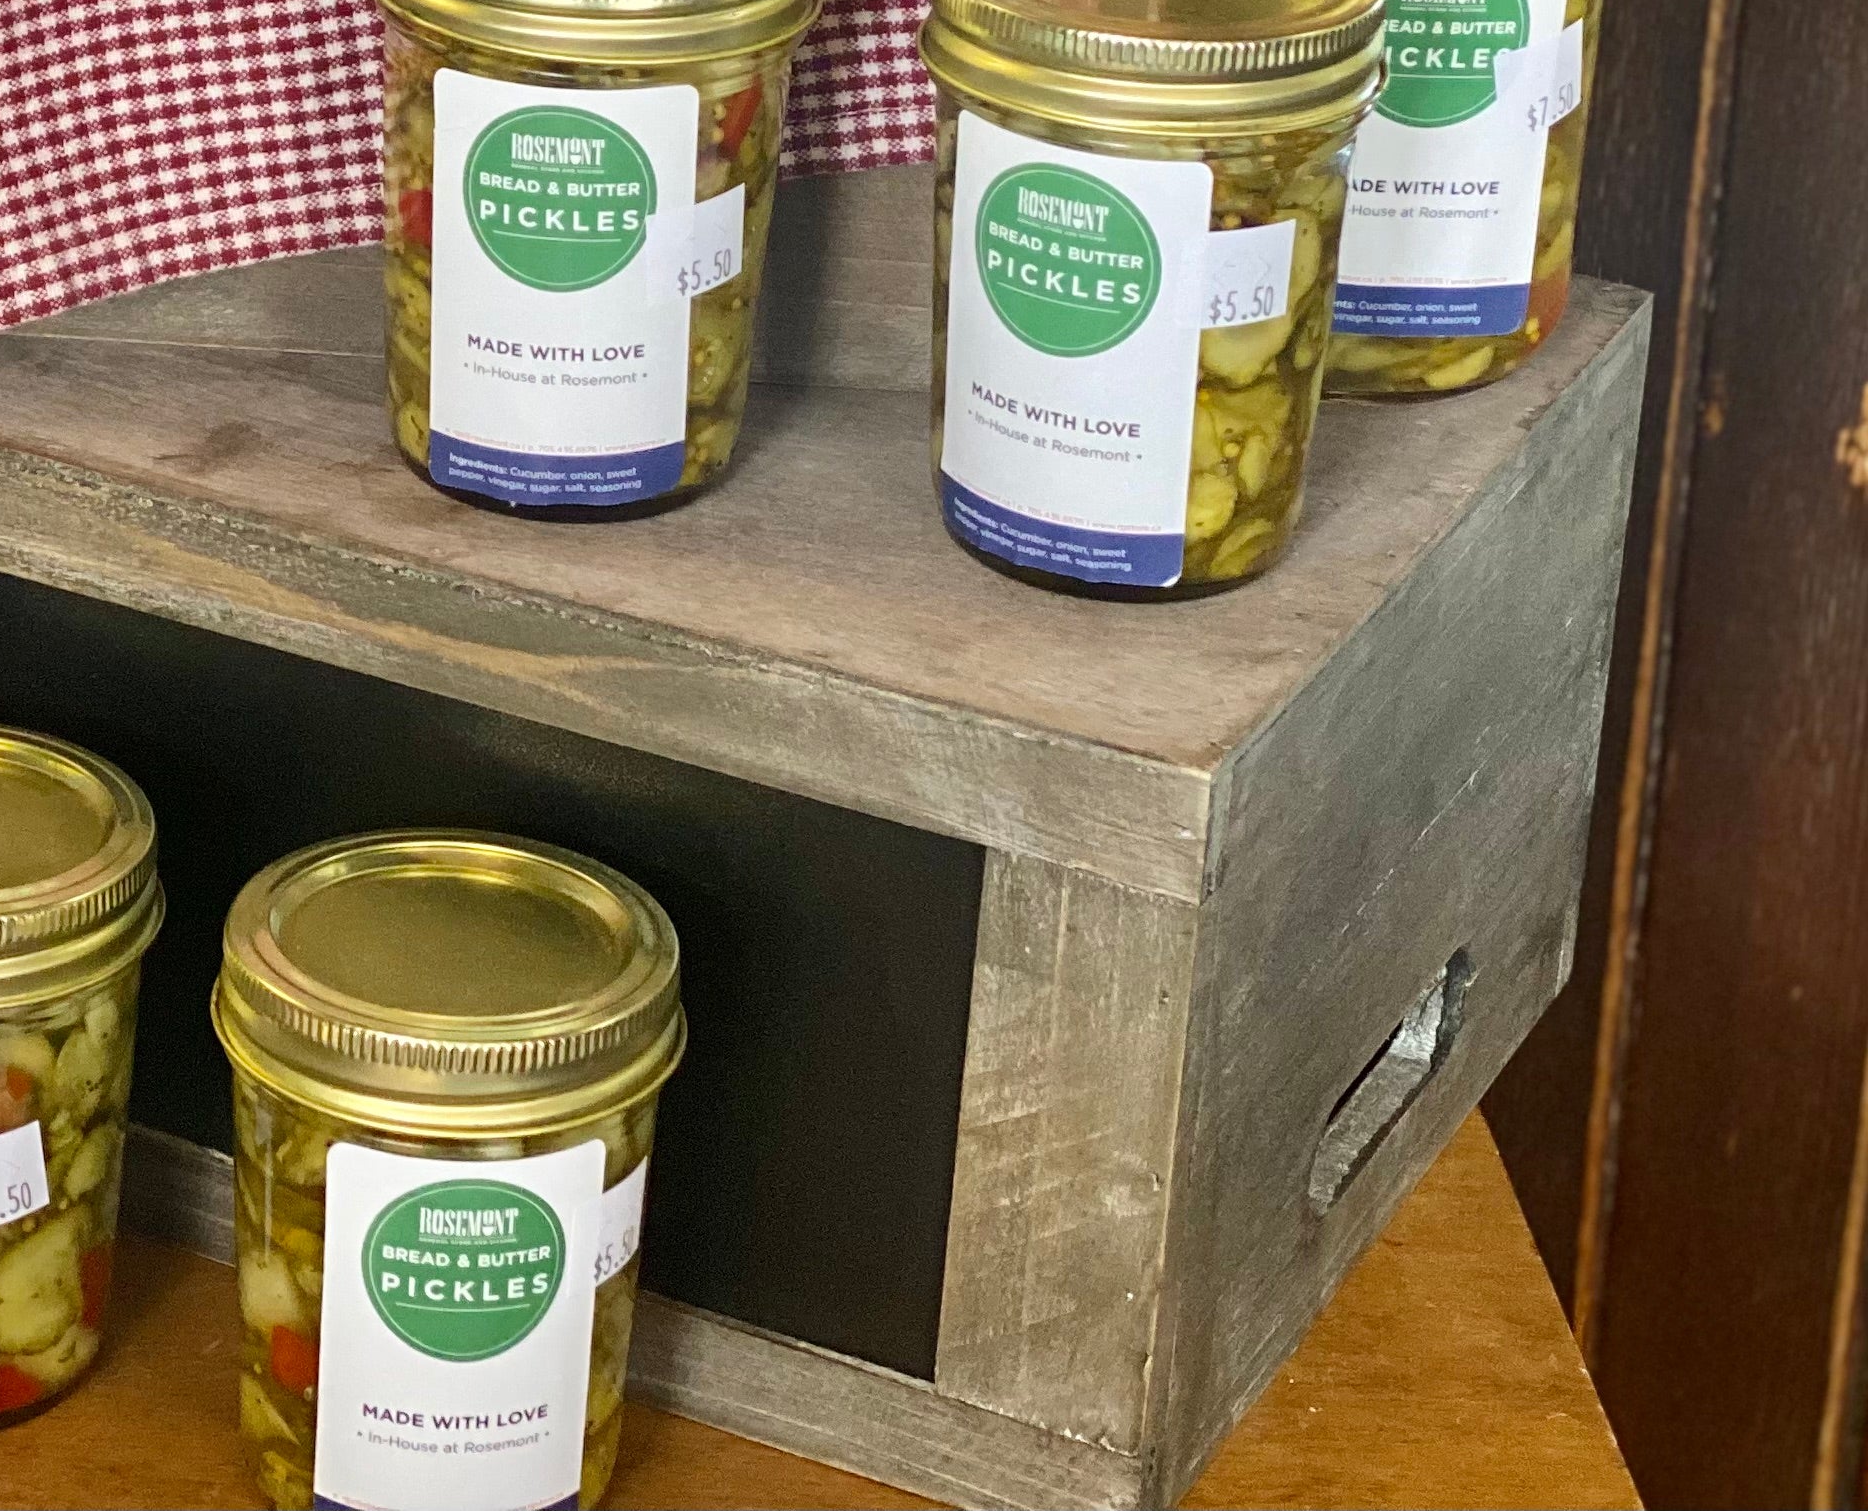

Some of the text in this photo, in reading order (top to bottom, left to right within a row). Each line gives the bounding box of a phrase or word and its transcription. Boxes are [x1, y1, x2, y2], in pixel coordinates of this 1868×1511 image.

[1382, 19, 1516, 35] READ & BUTTER
[1528, 83, 1573, 132] $7.50
[511, 132, 605, 165] ROSEMONT
[480, 172, 640, 196] BREAD & BUTTER
[1395, 181, 1499, 195] WITH LOVE
[480, 199, 639, 231] PICKLES
[1018, 186, 1109, 234] ROSEMONT
[1401, 207, 1489, 218] at Rosemont
[989, 221, 1043, 251] BREAD
[1049, 241, 1060, 256] &
[1069, 246, 1143, 270] BUTTER
[678, 249, 731, 296] $5.50
[988, 248, 1140, 304] PICKLES
[1209, 287, 1273, 323] $5.50
[468, 334, 645, 362] MADE WITH LOVE
[473, 362, 637, 385] In-House at Rosemont
[972, 381, 1140, 439] MADE WITH LOVE
[419, 1207, 519, 1237] ROSEMONT
[383, 1245, 551, 1268] BREAD & BUTTER
[382, 1272, 548, 1302] PICKLES
[363, 1403, 548, 1429] MADE WITH LOVE
